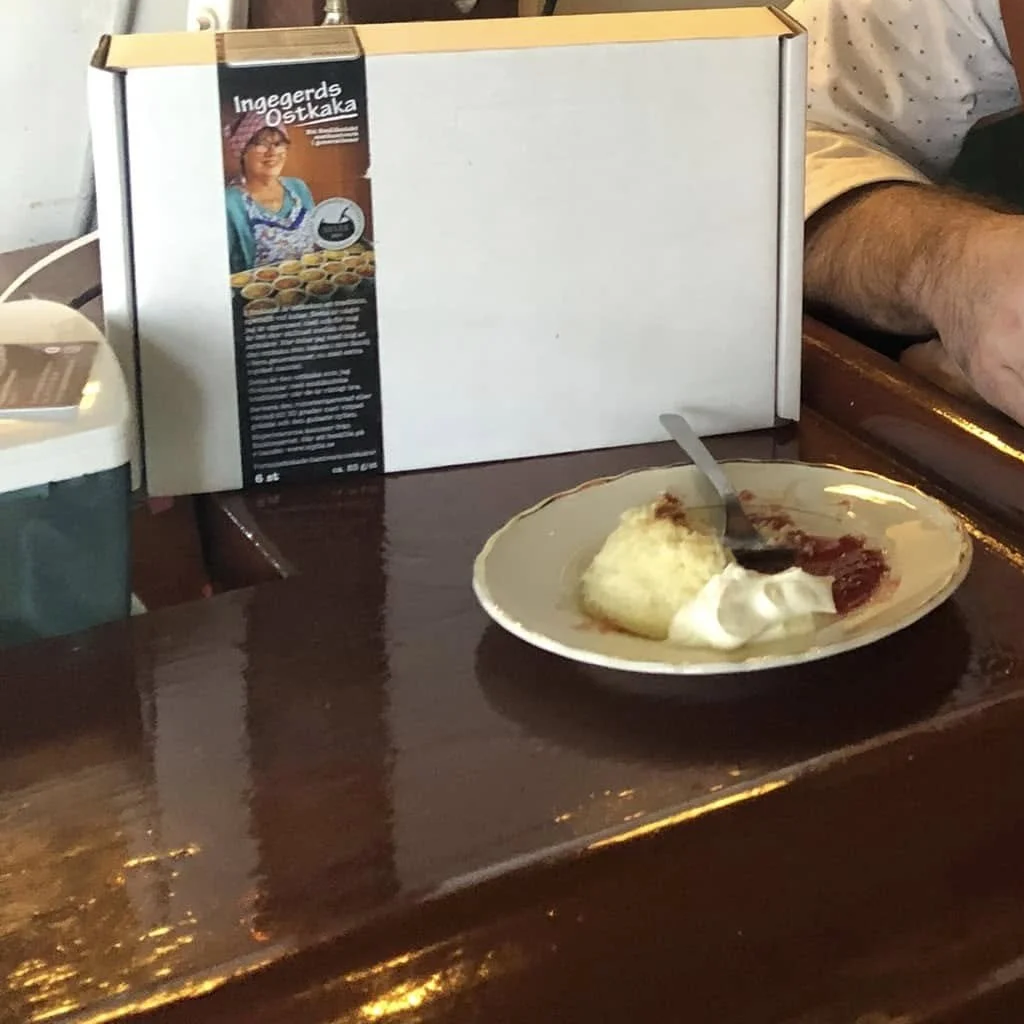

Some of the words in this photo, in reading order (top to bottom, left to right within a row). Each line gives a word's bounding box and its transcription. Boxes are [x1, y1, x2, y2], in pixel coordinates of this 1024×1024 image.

[233, 80, 342, 115] Ingegerds
[266, 98, 357, 127] Ostkaka
[255, 473, 264, 483] 6
[266, 472, 280, 483] st
